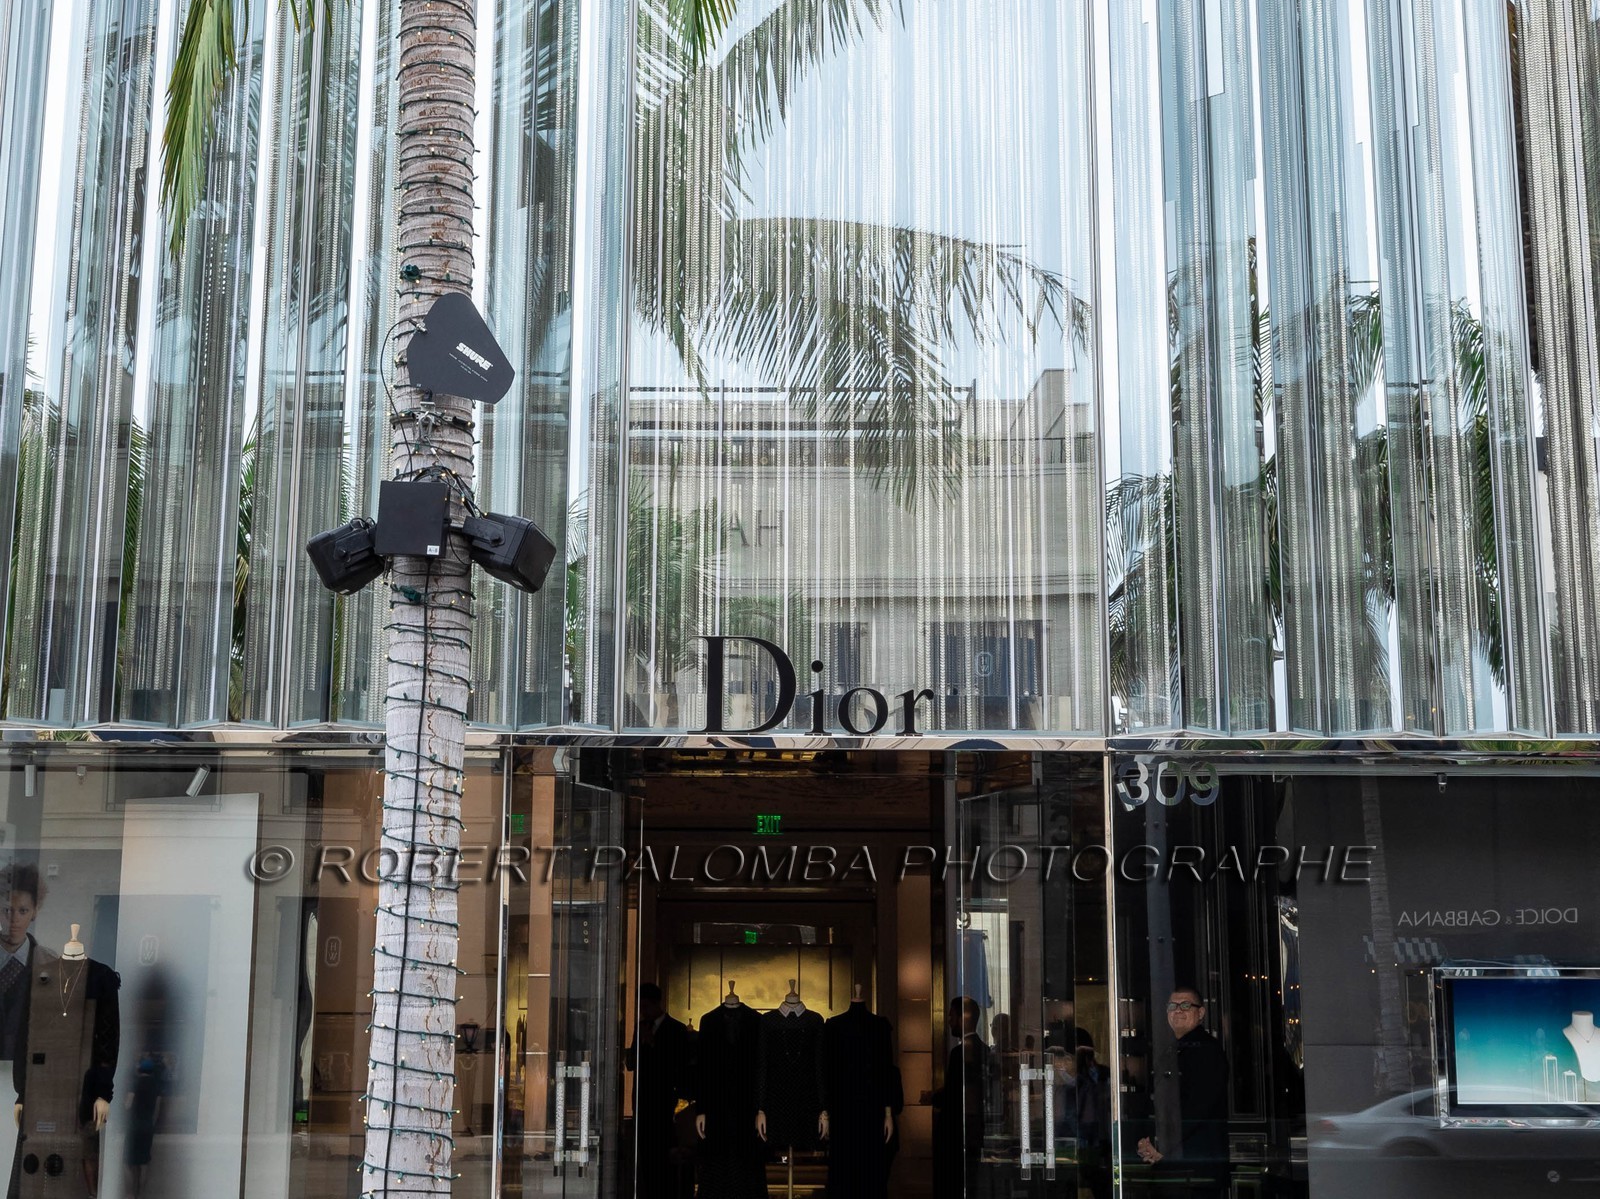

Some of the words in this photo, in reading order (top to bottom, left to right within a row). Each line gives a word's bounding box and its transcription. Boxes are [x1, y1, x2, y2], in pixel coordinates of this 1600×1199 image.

[455, 342, 492, 371] SHURE
[687, 635, 934, 735] Dior
[1116, 760, 1219, 807] 309
[756, 814, 781, 833] EXIT
